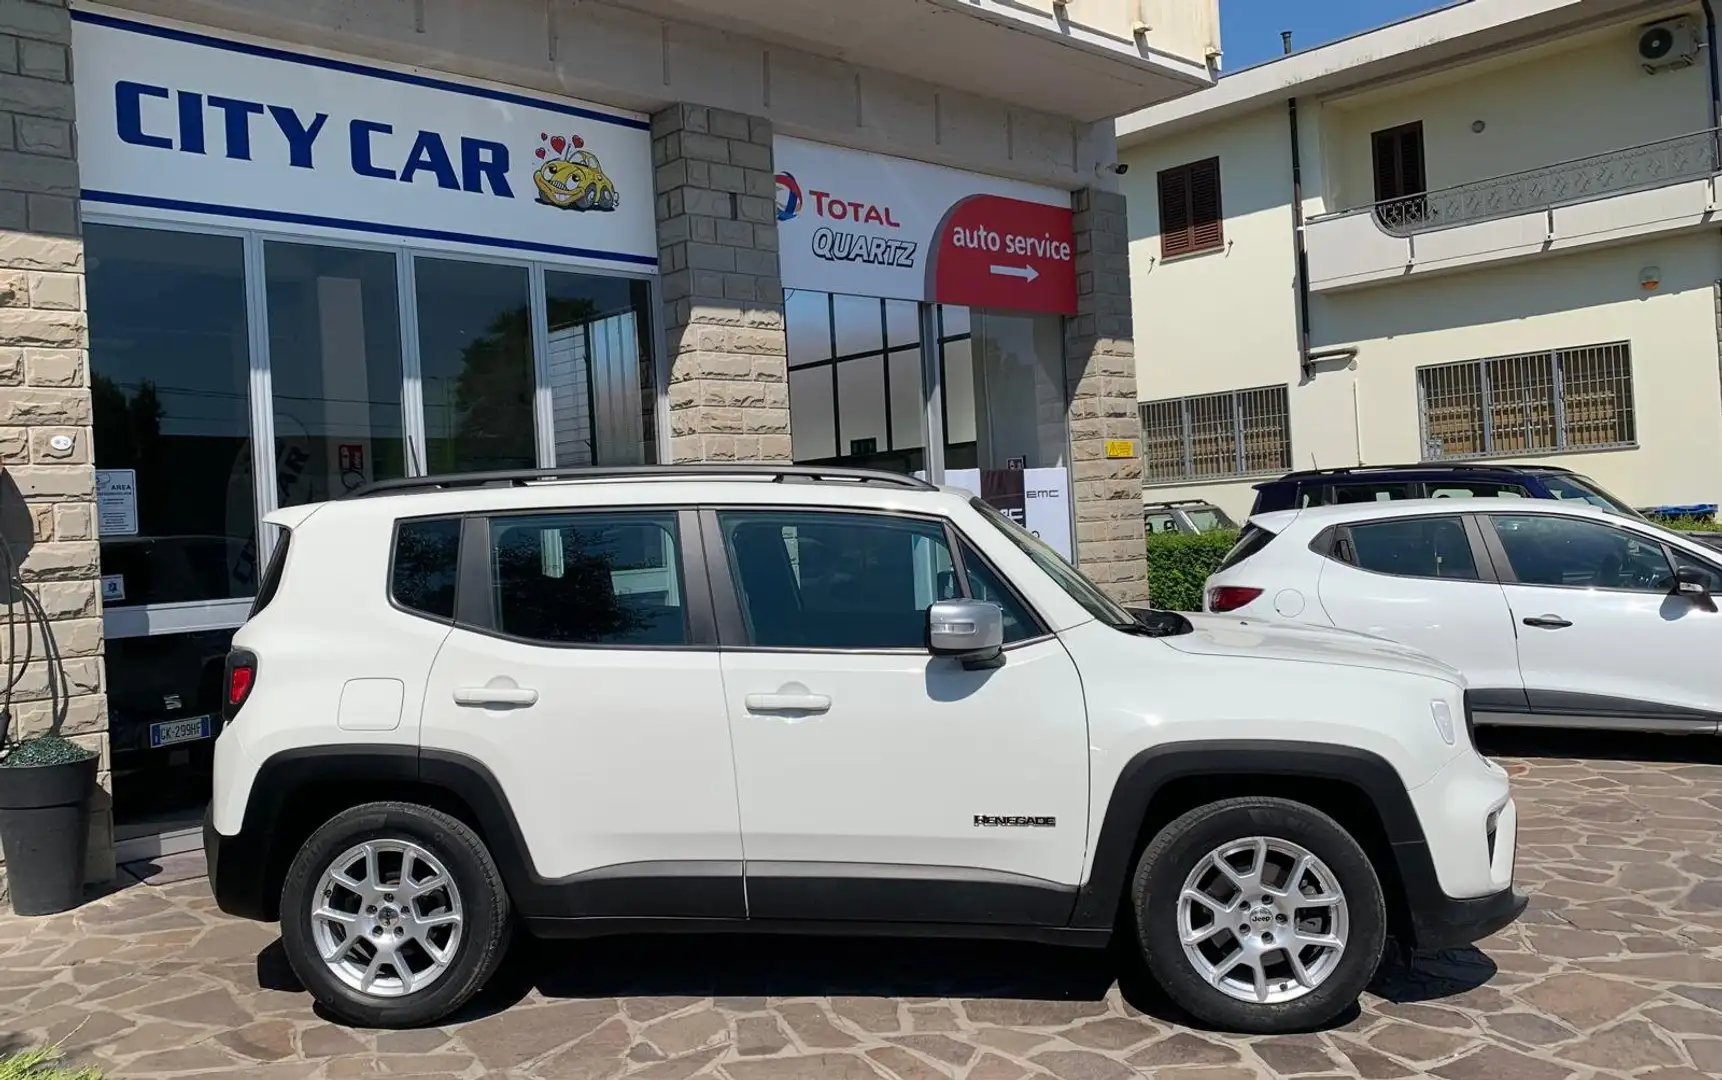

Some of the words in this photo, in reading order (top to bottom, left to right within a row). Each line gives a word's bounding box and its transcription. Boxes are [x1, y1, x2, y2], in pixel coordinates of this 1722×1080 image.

[115, 80, 329, 169] CITY
[349, 119, 515, 198] CAR
[809, 190, 900, 227] TOTAL
[812, 227, 917, 268] QUARTZ
[953, 224, 1000, 252] auto
[1005, 232, 1070, 261] service
[974, 815, 1056, 826] RENEGADE
[1252, 915, 1271, 923] Jeep
